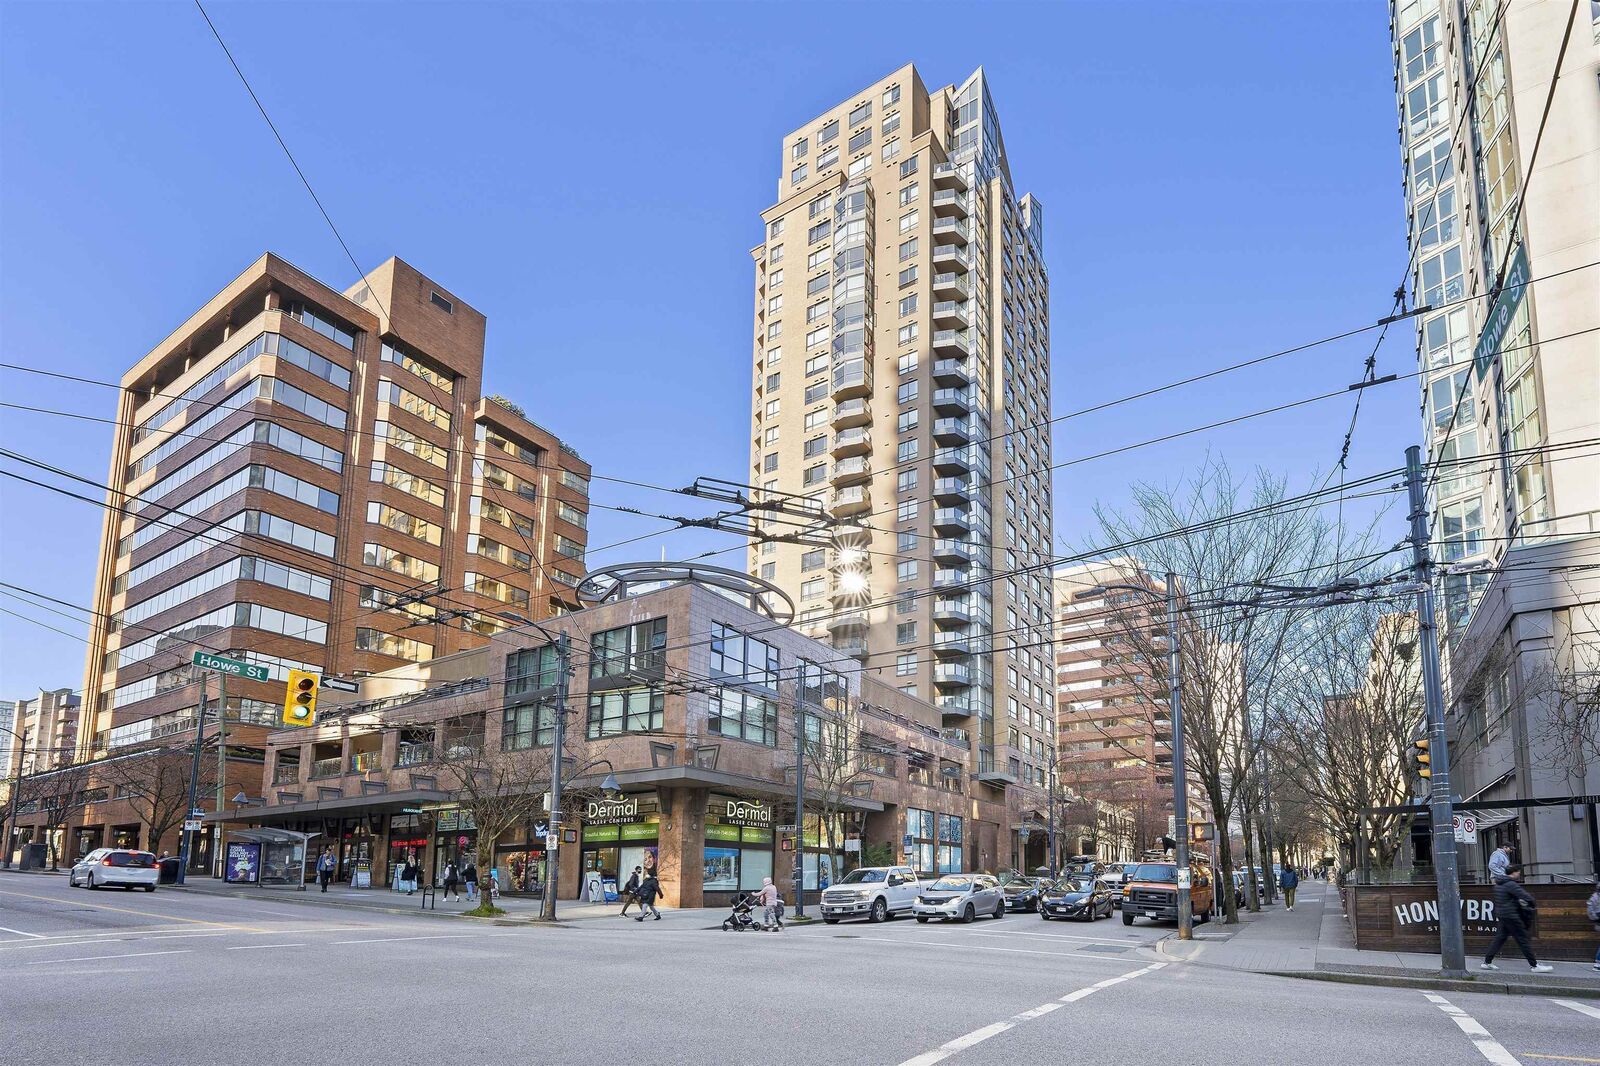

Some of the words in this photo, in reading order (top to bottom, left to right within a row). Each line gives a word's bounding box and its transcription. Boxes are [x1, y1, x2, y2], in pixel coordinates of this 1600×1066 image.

[1478, 303, 1509, 370] Howe
[1510, 263, 1525, 302] St
[199, 654, 241, 674] Howe
[246, 666, 263, 680] St
[588, 798, 639, 818] Dermal
[726, 800, 772, 822] Dermal
[608, 816, 635, 825] CENTRES
[746, 820, 770, 828] CENTRES
[1394, 899, 1500, 926] HONBR
